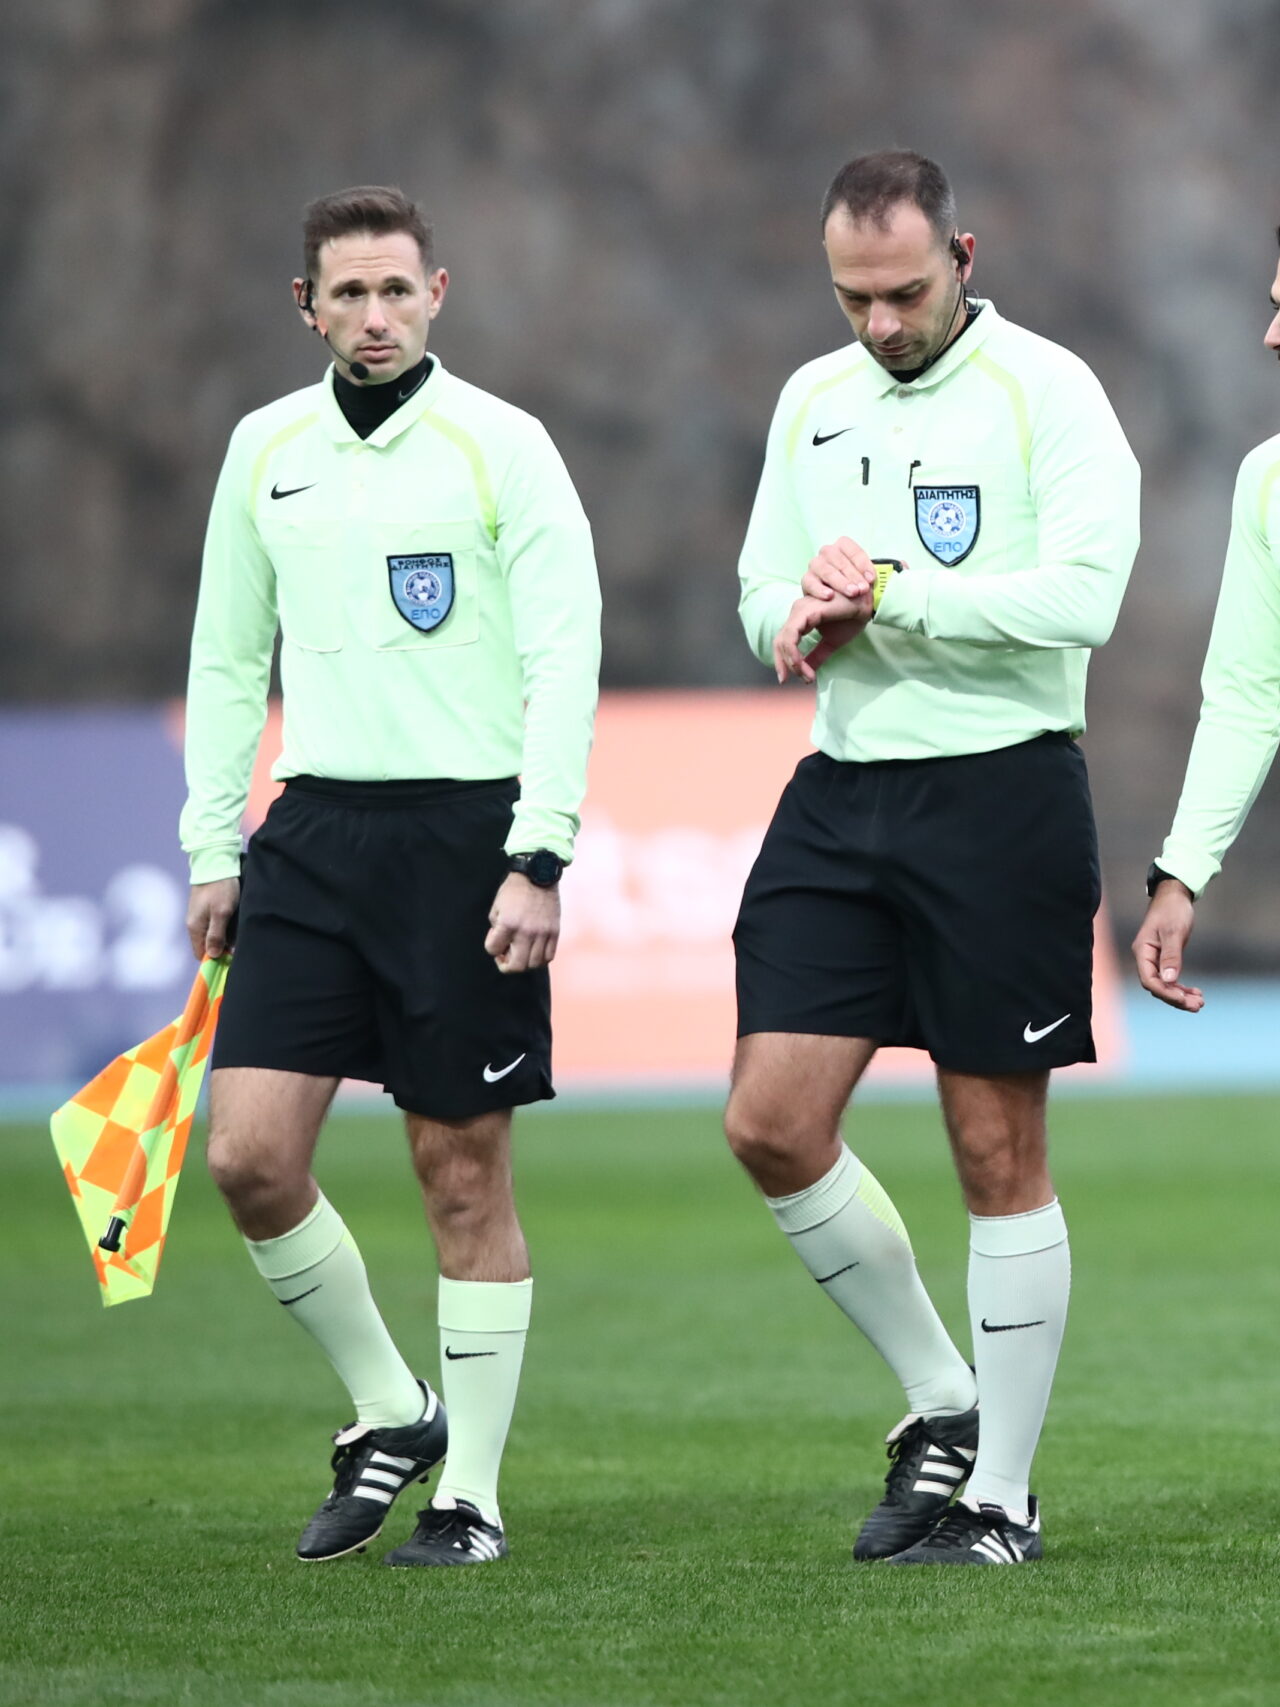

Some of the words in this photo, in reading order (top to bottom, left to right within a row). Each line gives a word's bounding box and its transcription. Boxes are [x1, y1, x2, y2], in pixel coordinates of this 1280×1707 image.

[918, 489, 976, 500] ΔΙΑΙΤΗΤΗΣ
[934, 541, 962, 552] ΕΠΟ
[411, 608, 441, 620] ΕΠΟ
